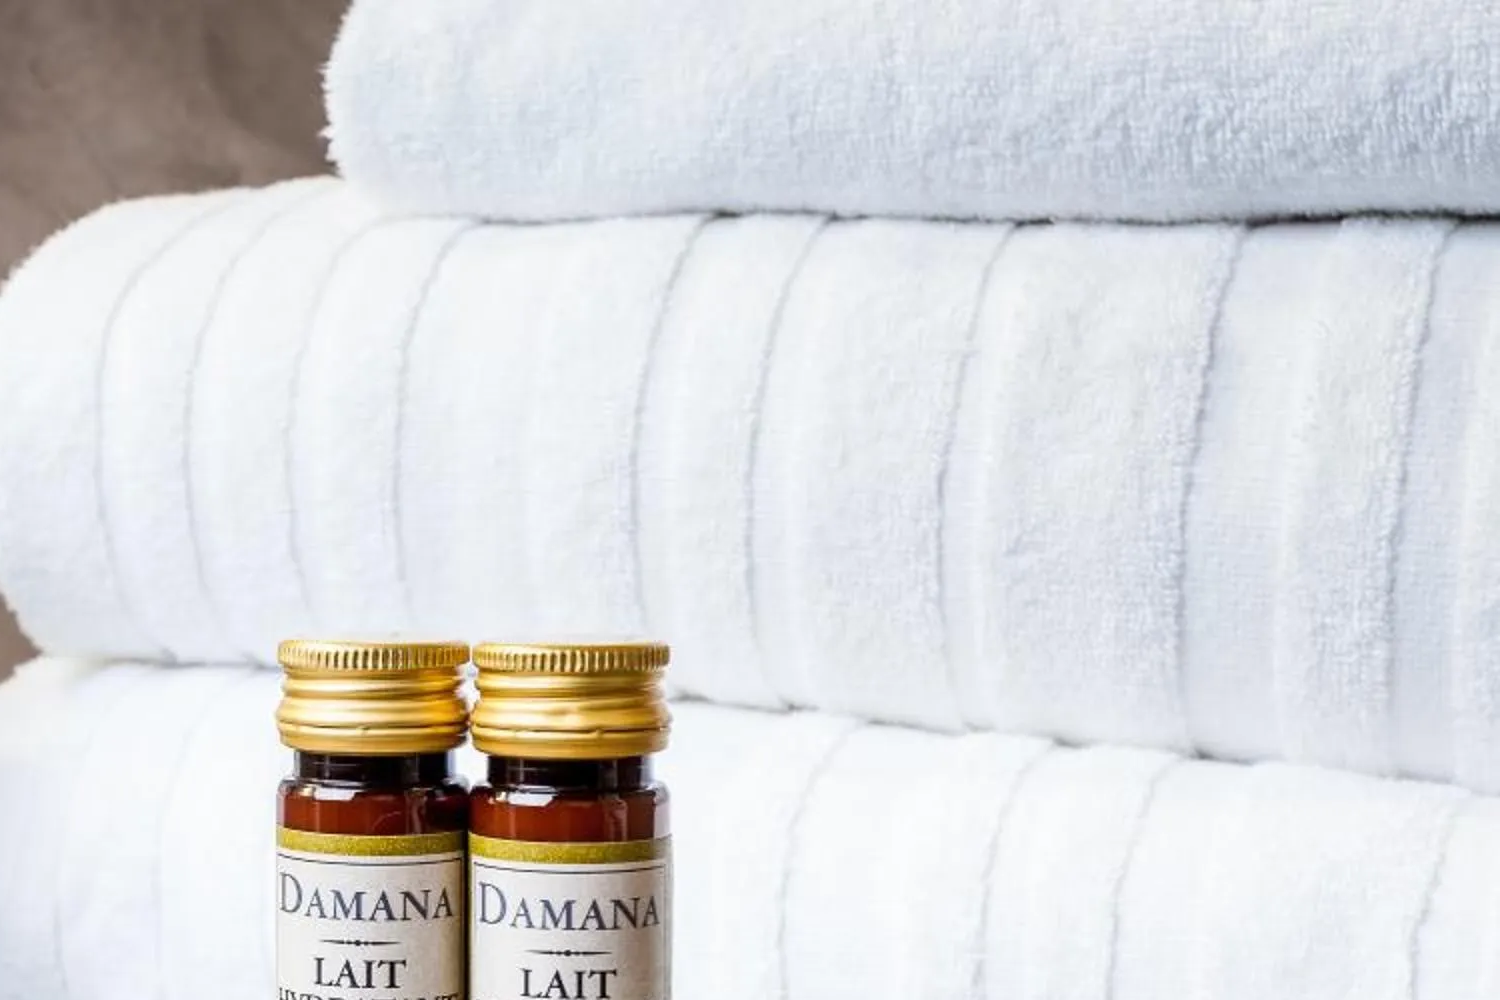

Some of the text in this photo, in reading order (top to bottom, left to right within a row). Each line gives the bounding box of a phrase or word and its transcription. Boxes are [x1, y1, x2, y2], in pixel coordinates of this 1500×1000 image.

[280, 871, 454, 921] DAMANA
[478, 881, 660, 931] DAMANA
[314, 956, 407, 989] LAIT
[520, 967, 617, 1000] LAIT
